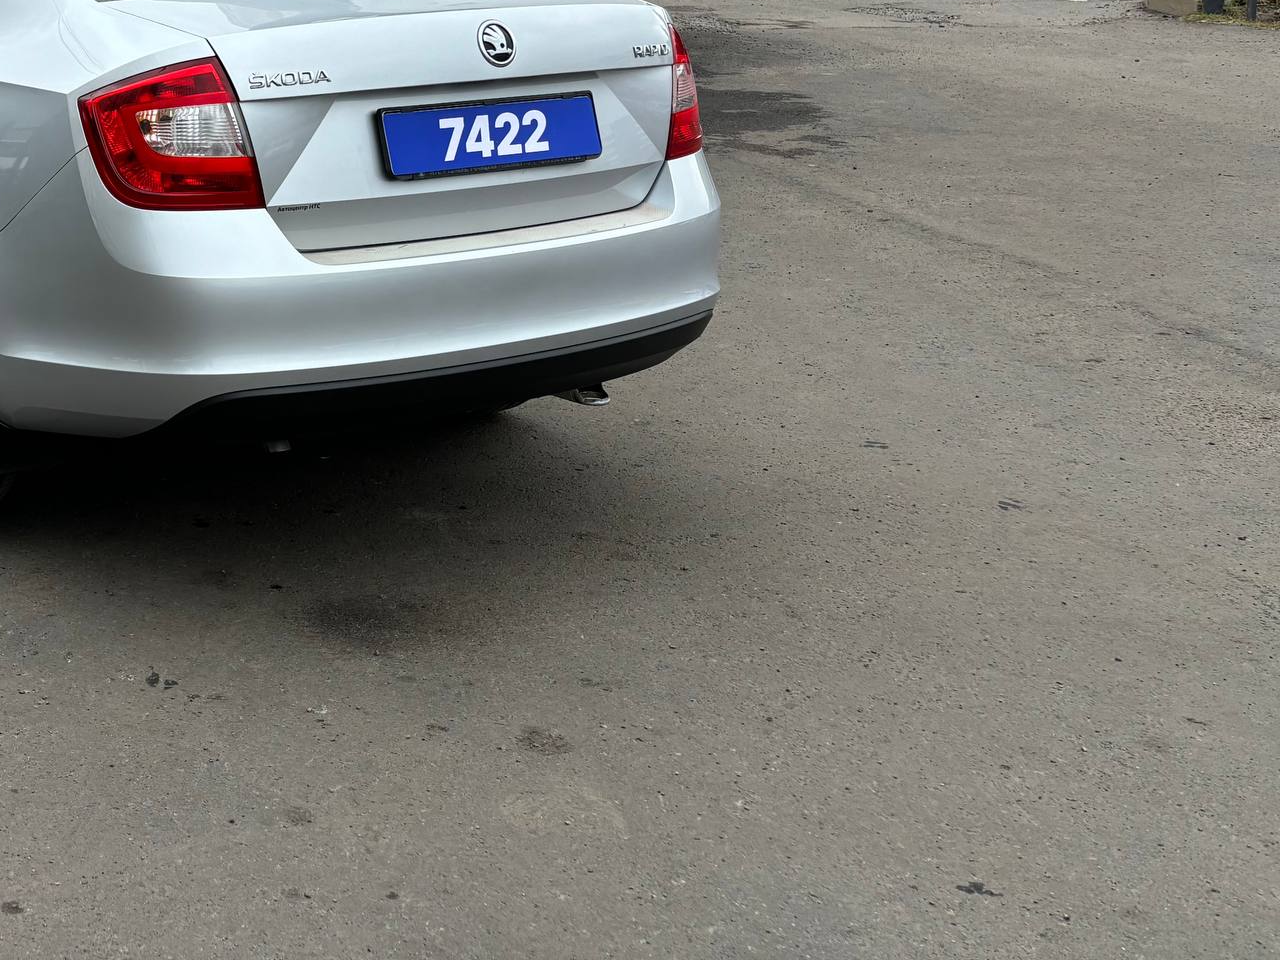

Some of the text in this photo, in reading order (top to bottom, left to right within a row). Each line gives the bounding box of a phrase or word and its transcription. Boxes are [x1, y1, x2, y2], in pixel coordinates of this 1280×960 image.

[632, 43, 671, 59] RAPID
[247, 69, 332, 90] ŠKODA
[438, 109, 551, 162] 7422
